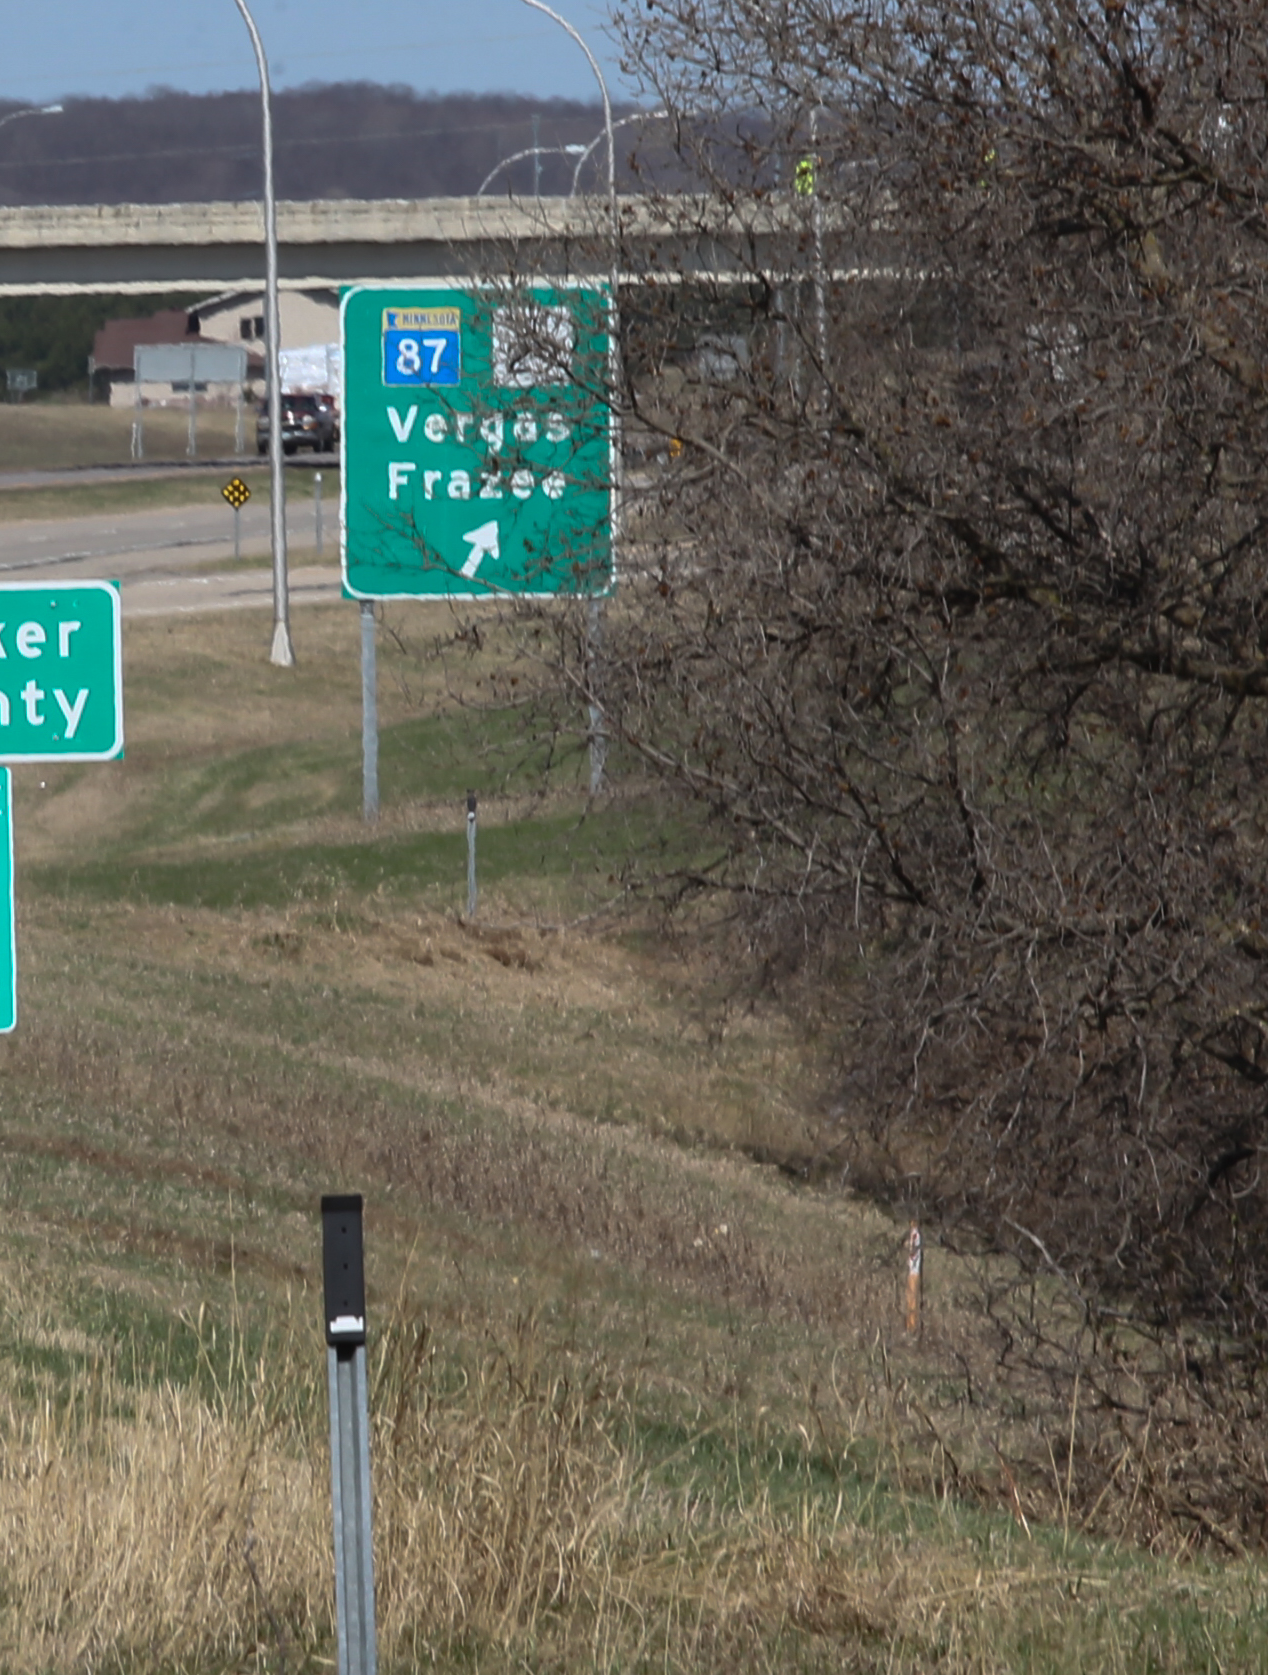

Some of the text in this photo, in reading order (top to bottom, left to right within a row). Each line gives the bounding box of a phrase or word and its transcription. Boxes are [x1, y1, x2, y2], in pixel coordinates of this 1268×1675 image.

[396, 338, 447, 376] 87
[386, 405, 570, 454] Vergas
[388, 461, 566, 501] Frazee
